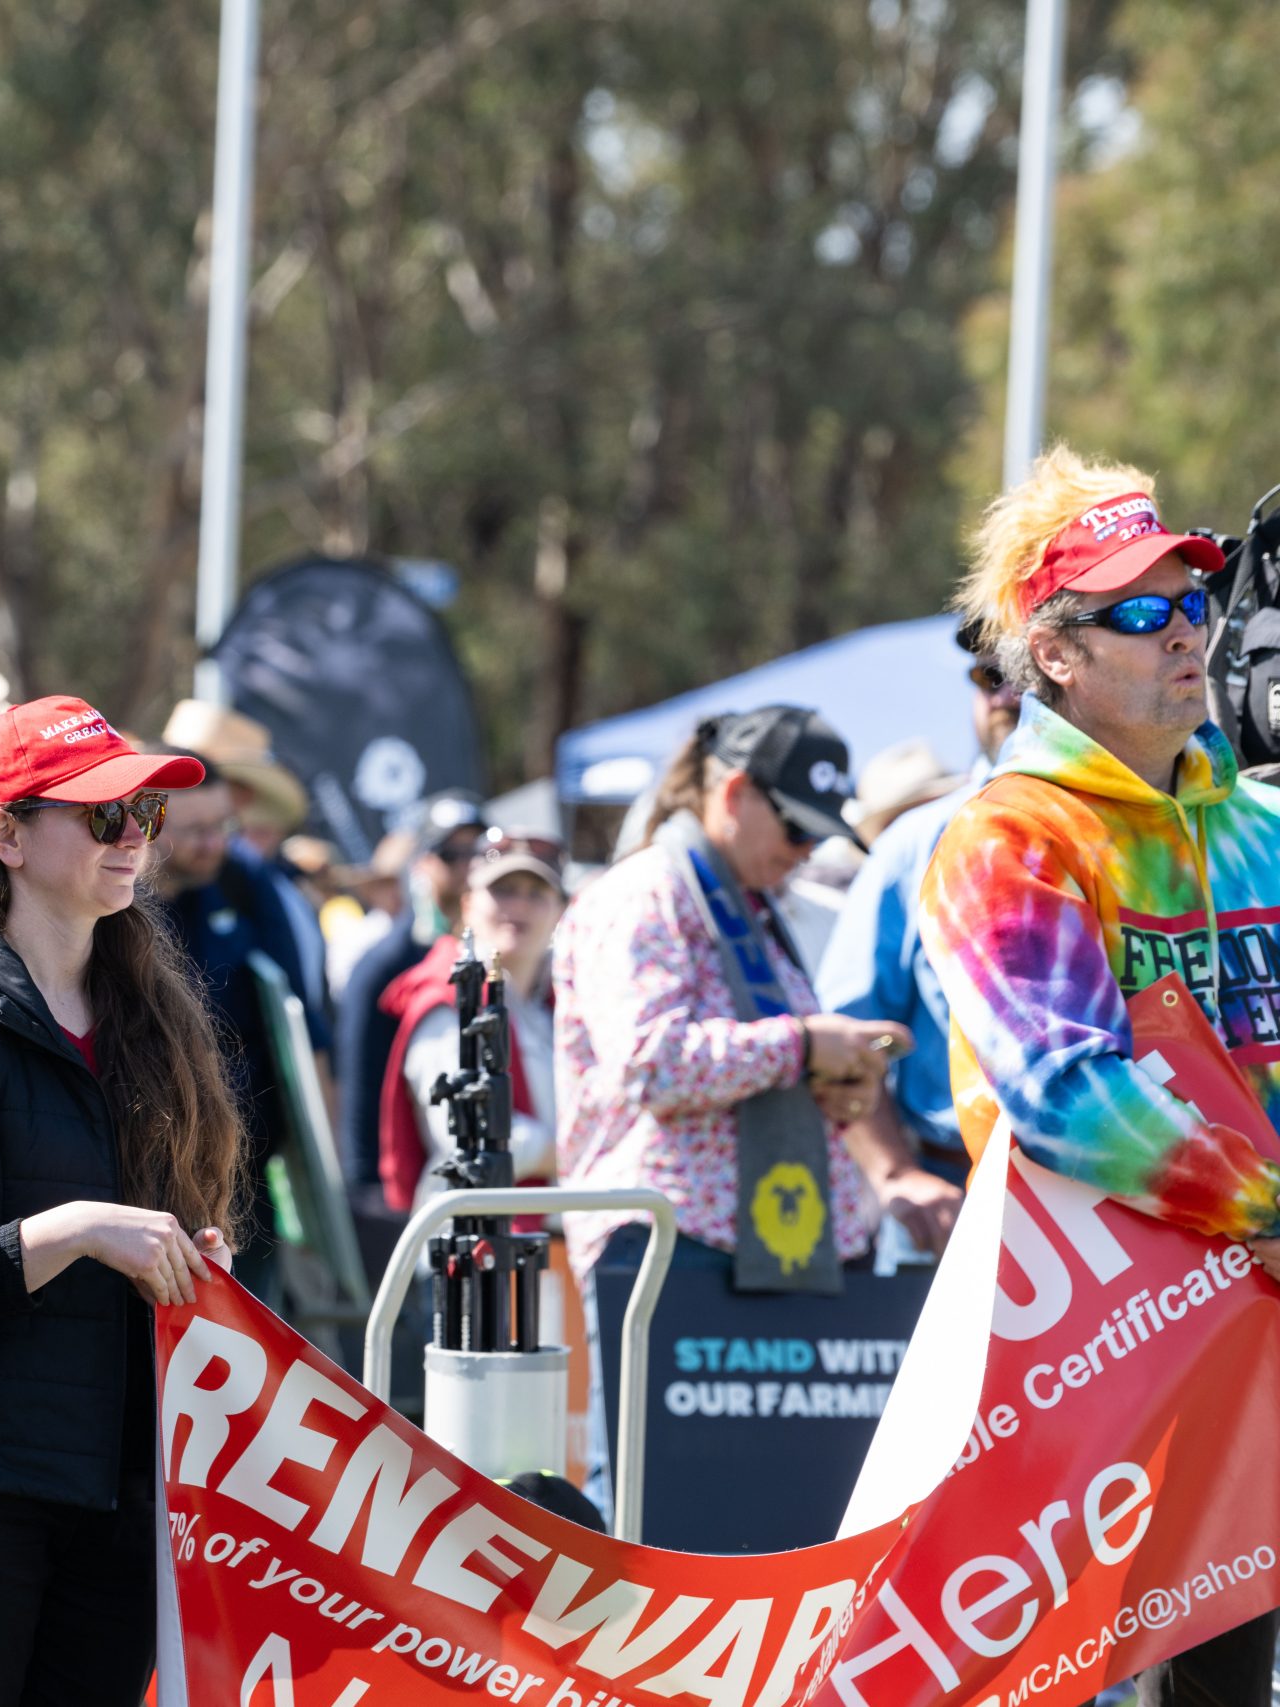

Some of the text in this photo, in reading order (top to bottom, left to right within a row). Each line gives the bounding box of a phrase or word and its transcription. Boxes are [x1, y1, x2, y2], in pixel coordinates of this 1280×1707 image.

[40, 716, 81, 740] MAKE
[64, 723, 106, 744] GREAT
[1023, 1244, 1263, 1410] Certificate
[674, 1337, 815, 1372] STAND
[664, 1380, 754, 1417] OUR
[203, 1532, 271, 1568] of
[248, 1556, 385, 1630] your
[371, 1622, 545, 1704] power
